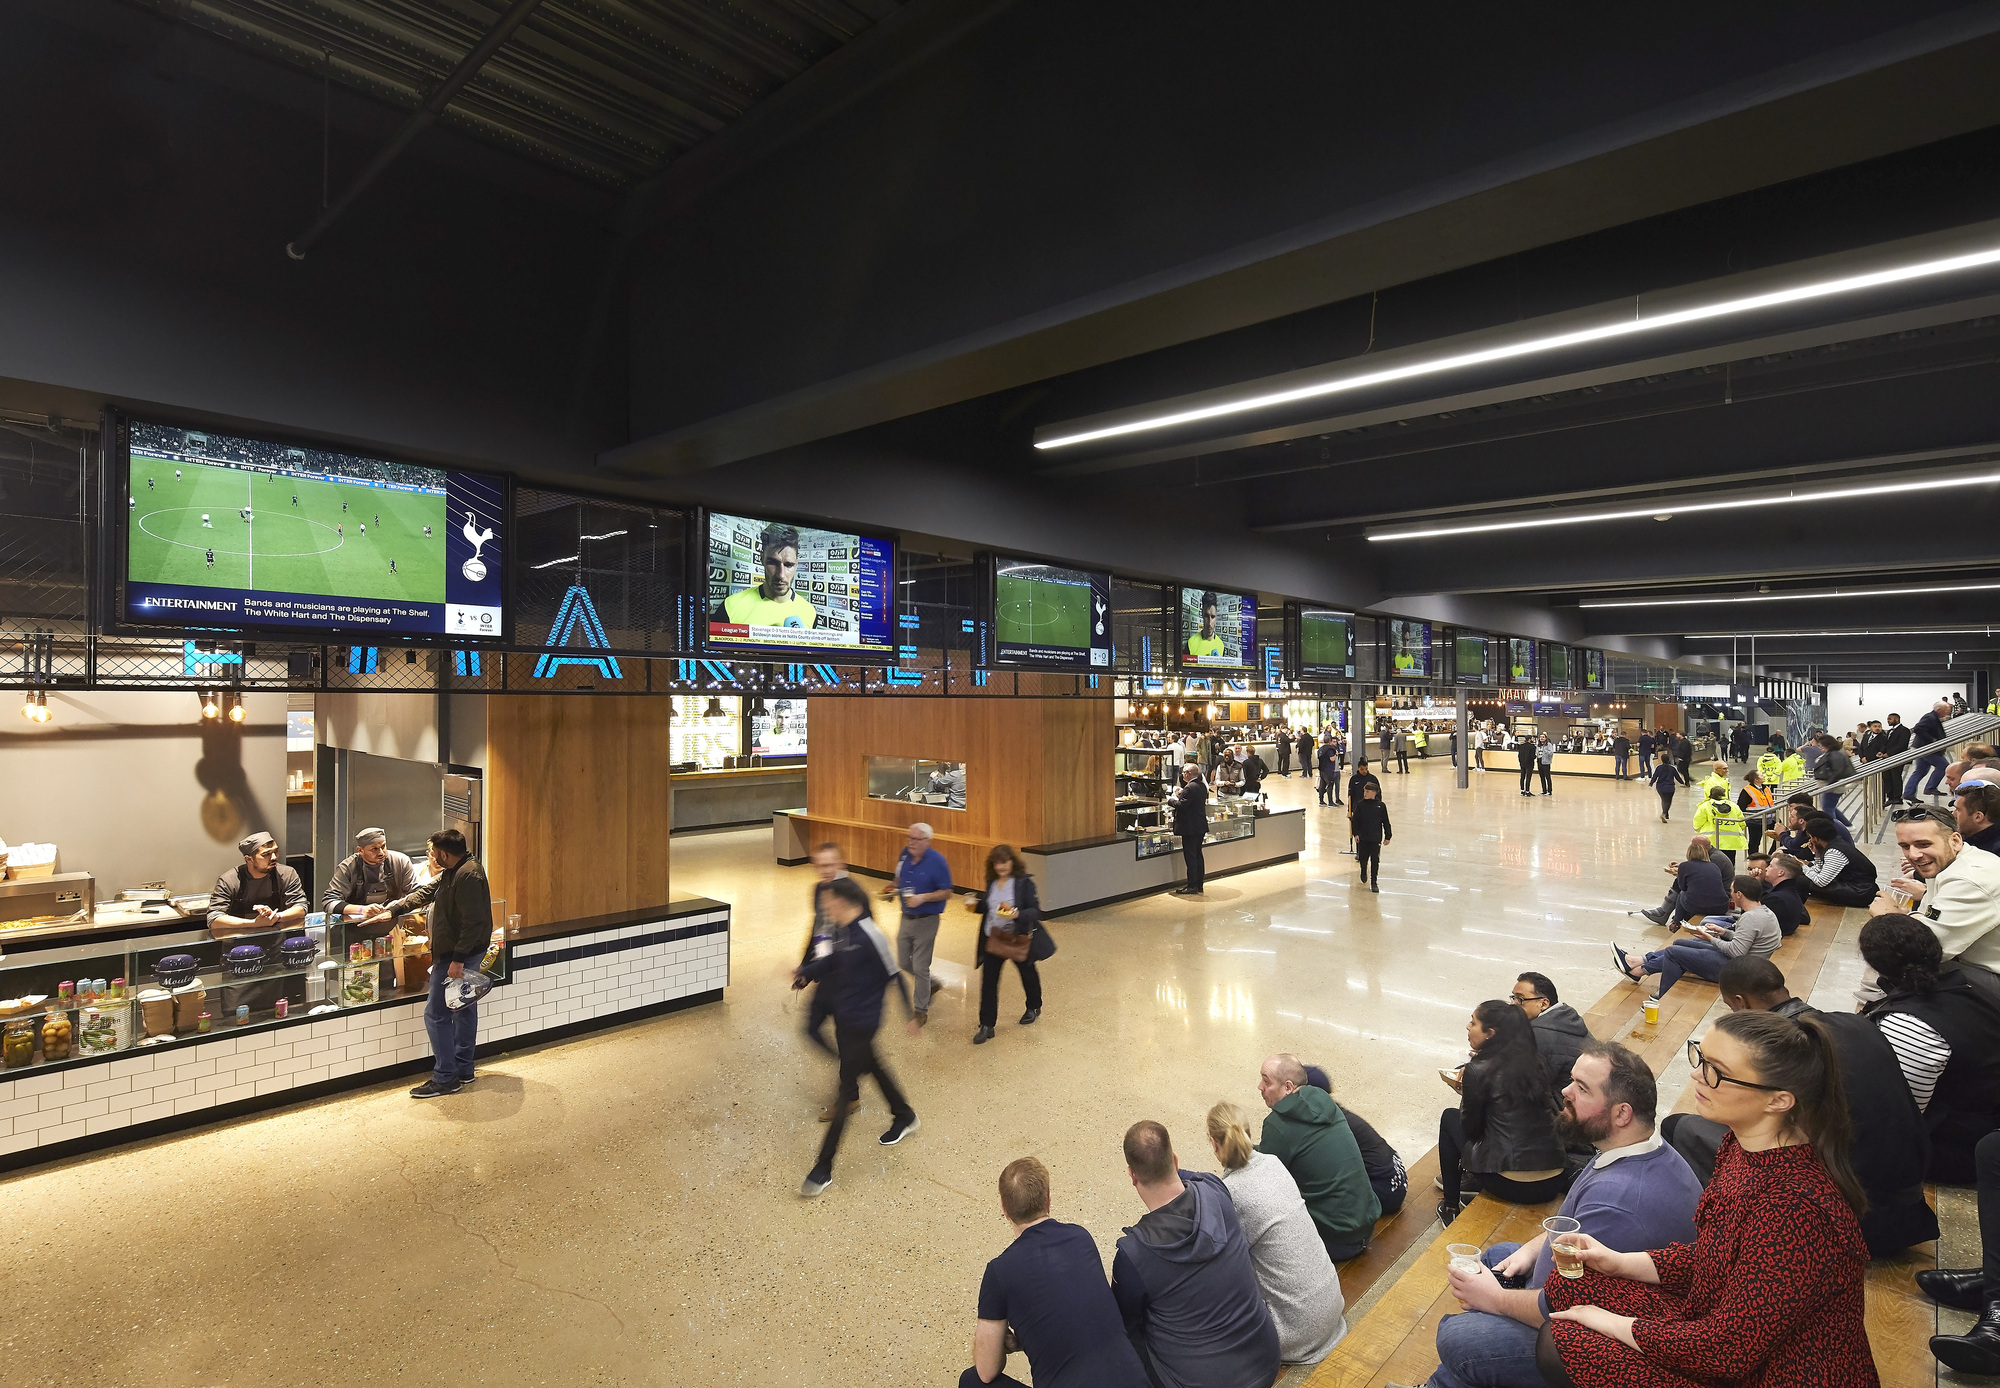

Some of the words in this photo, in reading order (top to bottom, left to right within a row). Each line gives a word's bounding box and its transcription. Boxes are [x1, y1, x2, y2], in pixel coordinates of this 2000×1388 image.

[710, 568, 725, 580] JD
[814, 582, 824, 590] JD
[145, 597, 238, 612] ENTERTAINMENT
[245, 598, 273, 608] Bands
[275, 600, 291, 609] and
[294, 602, 335, 612] musicians
[353, 606, 381, 616] playing
[392, 608, 407, 616] The
[244, 608, 261, 616] The
[263, 608, 289, 618] White
[291, 611, 310, 619] Hart
[312, 612, 328, 620] and
[330, 613, 346, 621] The
[348, 614, 392, 625] Dispensary
[721, 627, 738, 635] League
[1499, 688, 1528, 700] NAAN
[286, 955, 314, 966] Moules
[231, 963, 263, 975] Moules
[162, 974, 195, 986] Moules
